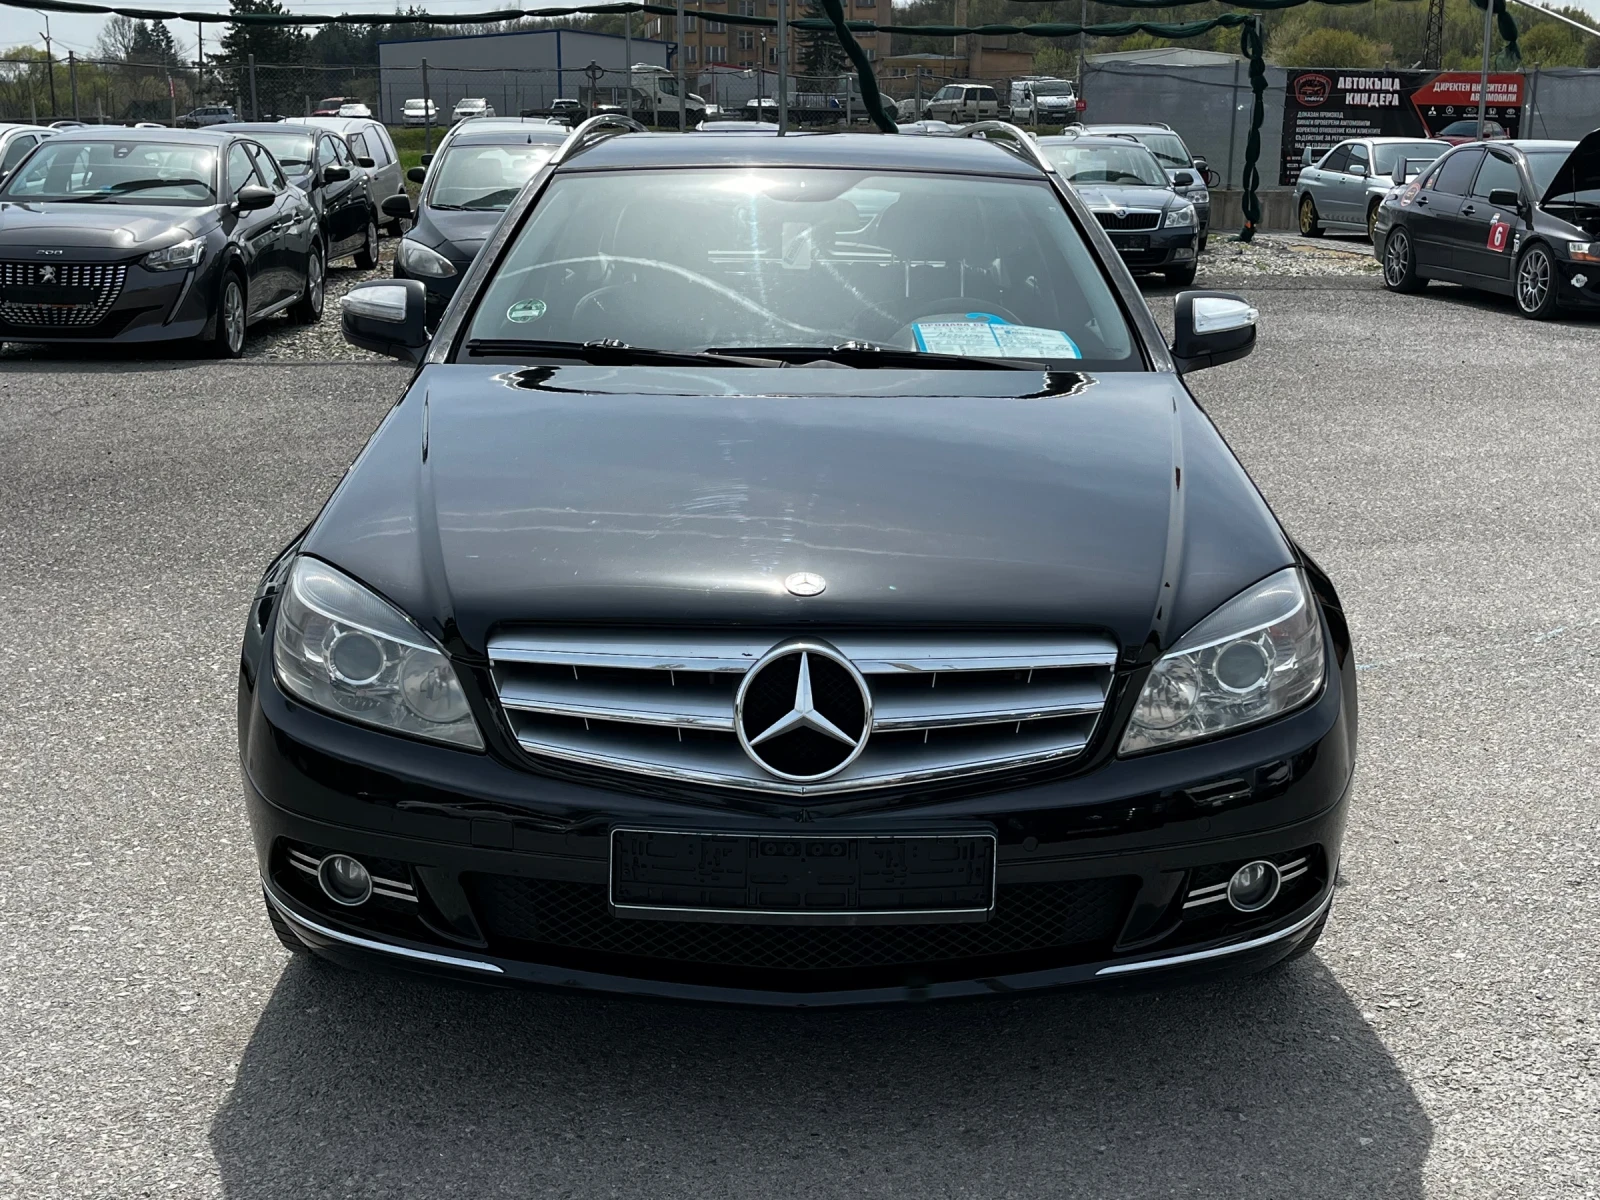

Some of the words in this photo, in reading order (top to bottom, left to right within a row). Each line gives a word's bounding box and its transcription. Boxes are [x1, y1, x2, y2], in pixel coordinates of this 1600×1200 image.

[1337, 77, 1400, 91] АВТОКЪЩА
[1433, 82, 1470, 92] ДИРЕКТЕН
[1472, 83, 1506, 92] ВНСИТЕЛ
[1508, 84, 1517, 92] НА
[1345, 92, 1399, 107] КИНДЕРА
[1470, 93, 1517, 102] АВМОБИЛИ
[1494, 226, 1503, 246] 6
